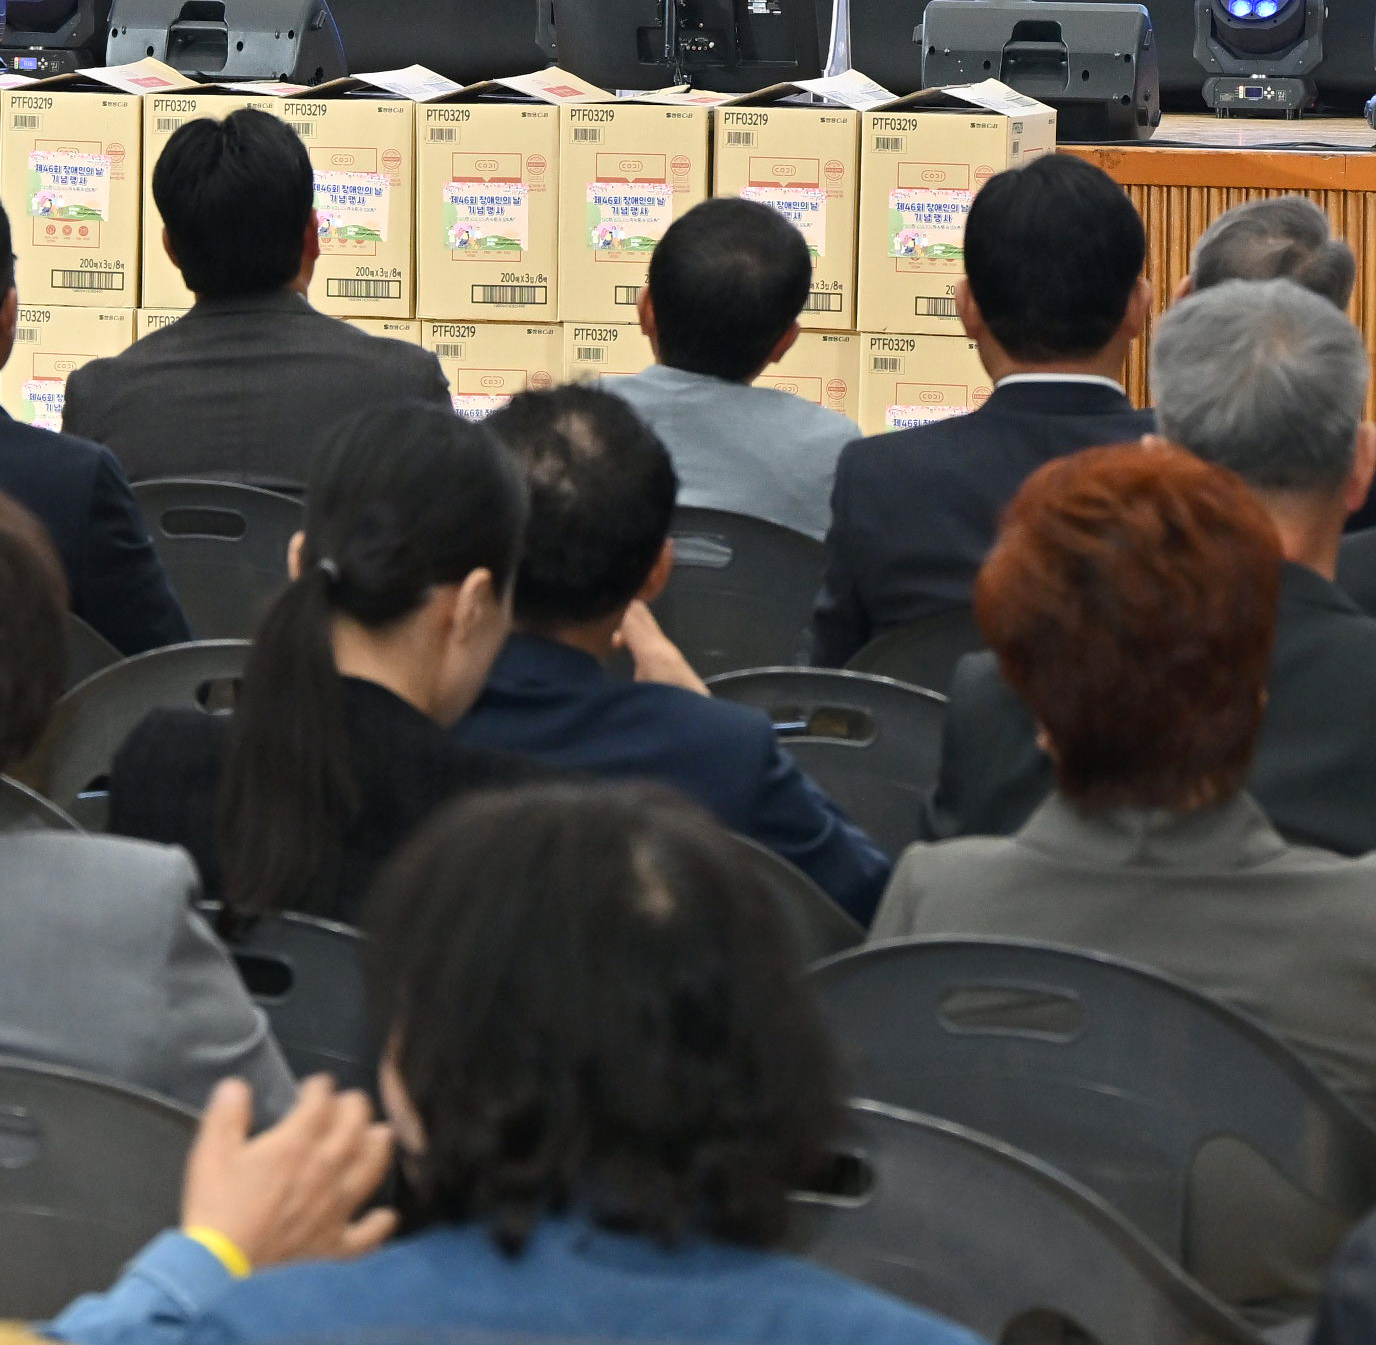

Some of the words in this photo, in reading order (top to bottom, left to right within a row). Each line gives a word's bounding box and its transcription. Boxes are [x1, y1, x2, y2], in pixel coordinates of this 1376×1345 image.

[11, 96, 53, 110] PTF03219
[153, 99, 197, 112] PTF03219
[284, 103, 328, 116] PTF03219
[426, 109, 471, 122] PTF03219
[570, 109, 615, 122] PTF03219
[724, 112, 769, 126] PTF03219
[872, 117, 918, 131] PTF03219
[16, 310, 51, 323] TF03219
[432, 325, 476, 338] PTF03219
[574, 328, 618, 342] PTF03219
[870, 337, 915, 351] PTF03219
